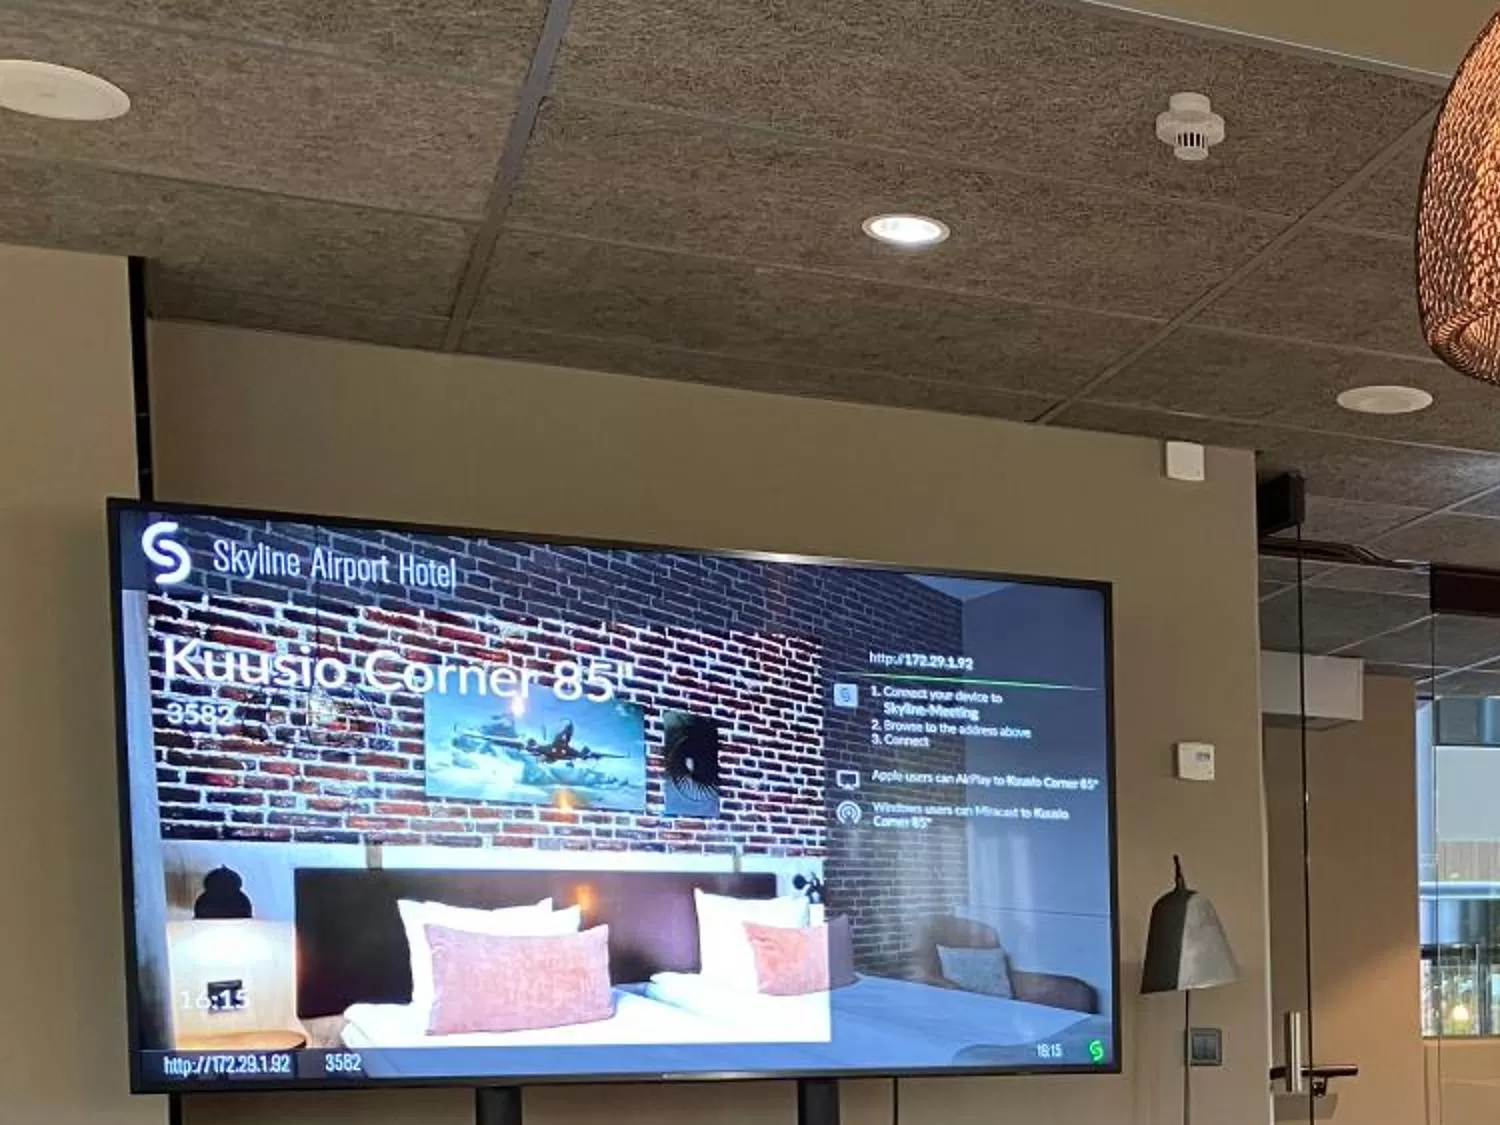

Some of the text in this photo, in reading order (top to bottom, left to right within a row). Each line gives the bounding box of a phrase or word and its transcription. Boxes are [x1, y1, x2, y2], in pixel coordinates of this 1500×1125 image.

[213, 539, 457, 588] Skyline Airport Hotel
[164, 637, 347, 689] Kuusio
[364, 649, 538, 700] Corner
[869, 650, 974, 671] http://172.29.1.92
[870, 685, 1003, 704] 1. Connect your device to
[166, 701, 234, 726] 3582
[883, 702, 980, 722] Skyline-Meeting
[871, 719, 1032, 739] 2. Browse to the address above
[871, 733, 930, 747] 3. Connect
[871, 769, 903, 784] Apple
[905, 773, 933, 784] users
[935, 774, 955, 784] can
[956, 773, 992, 787] AirPlay
[993, 775, 1004, 787] to
[1005, 775, 1042, 789] Kuusio
[1043, 776, 1079, 790] Corner
[872, 802, 1071, 820] Windows users can Miracast to Kuusio
[872, 815, 909, 828] Corner
[180, 988, 252, 1011] 16:15
[325, 1053, 362, 1072] 3582
